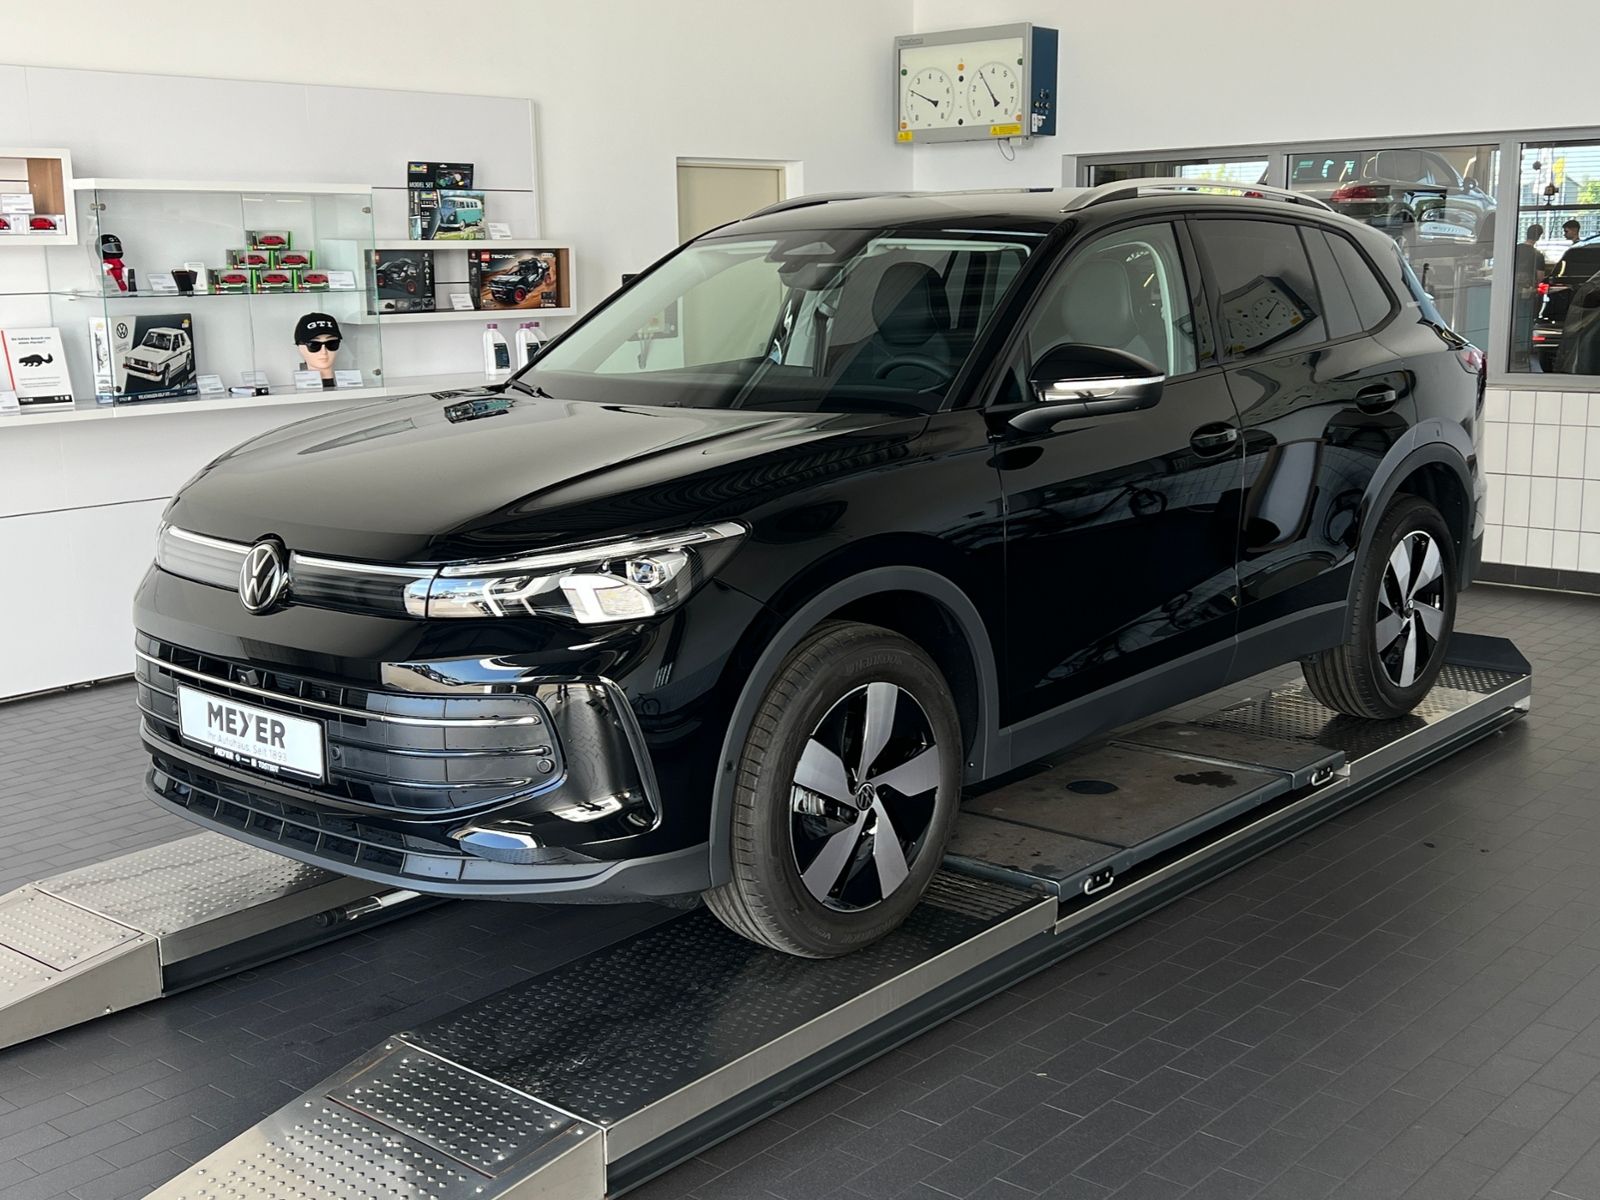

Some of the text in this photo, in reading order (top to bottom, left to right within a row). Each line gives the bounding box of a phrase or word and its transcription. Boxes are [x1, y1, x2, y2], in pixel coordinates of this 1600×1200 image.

[307, 320, 333, 329] GTI
[240, 540, 280, 609] VW
[207, 701, 286, 749] MEYER
